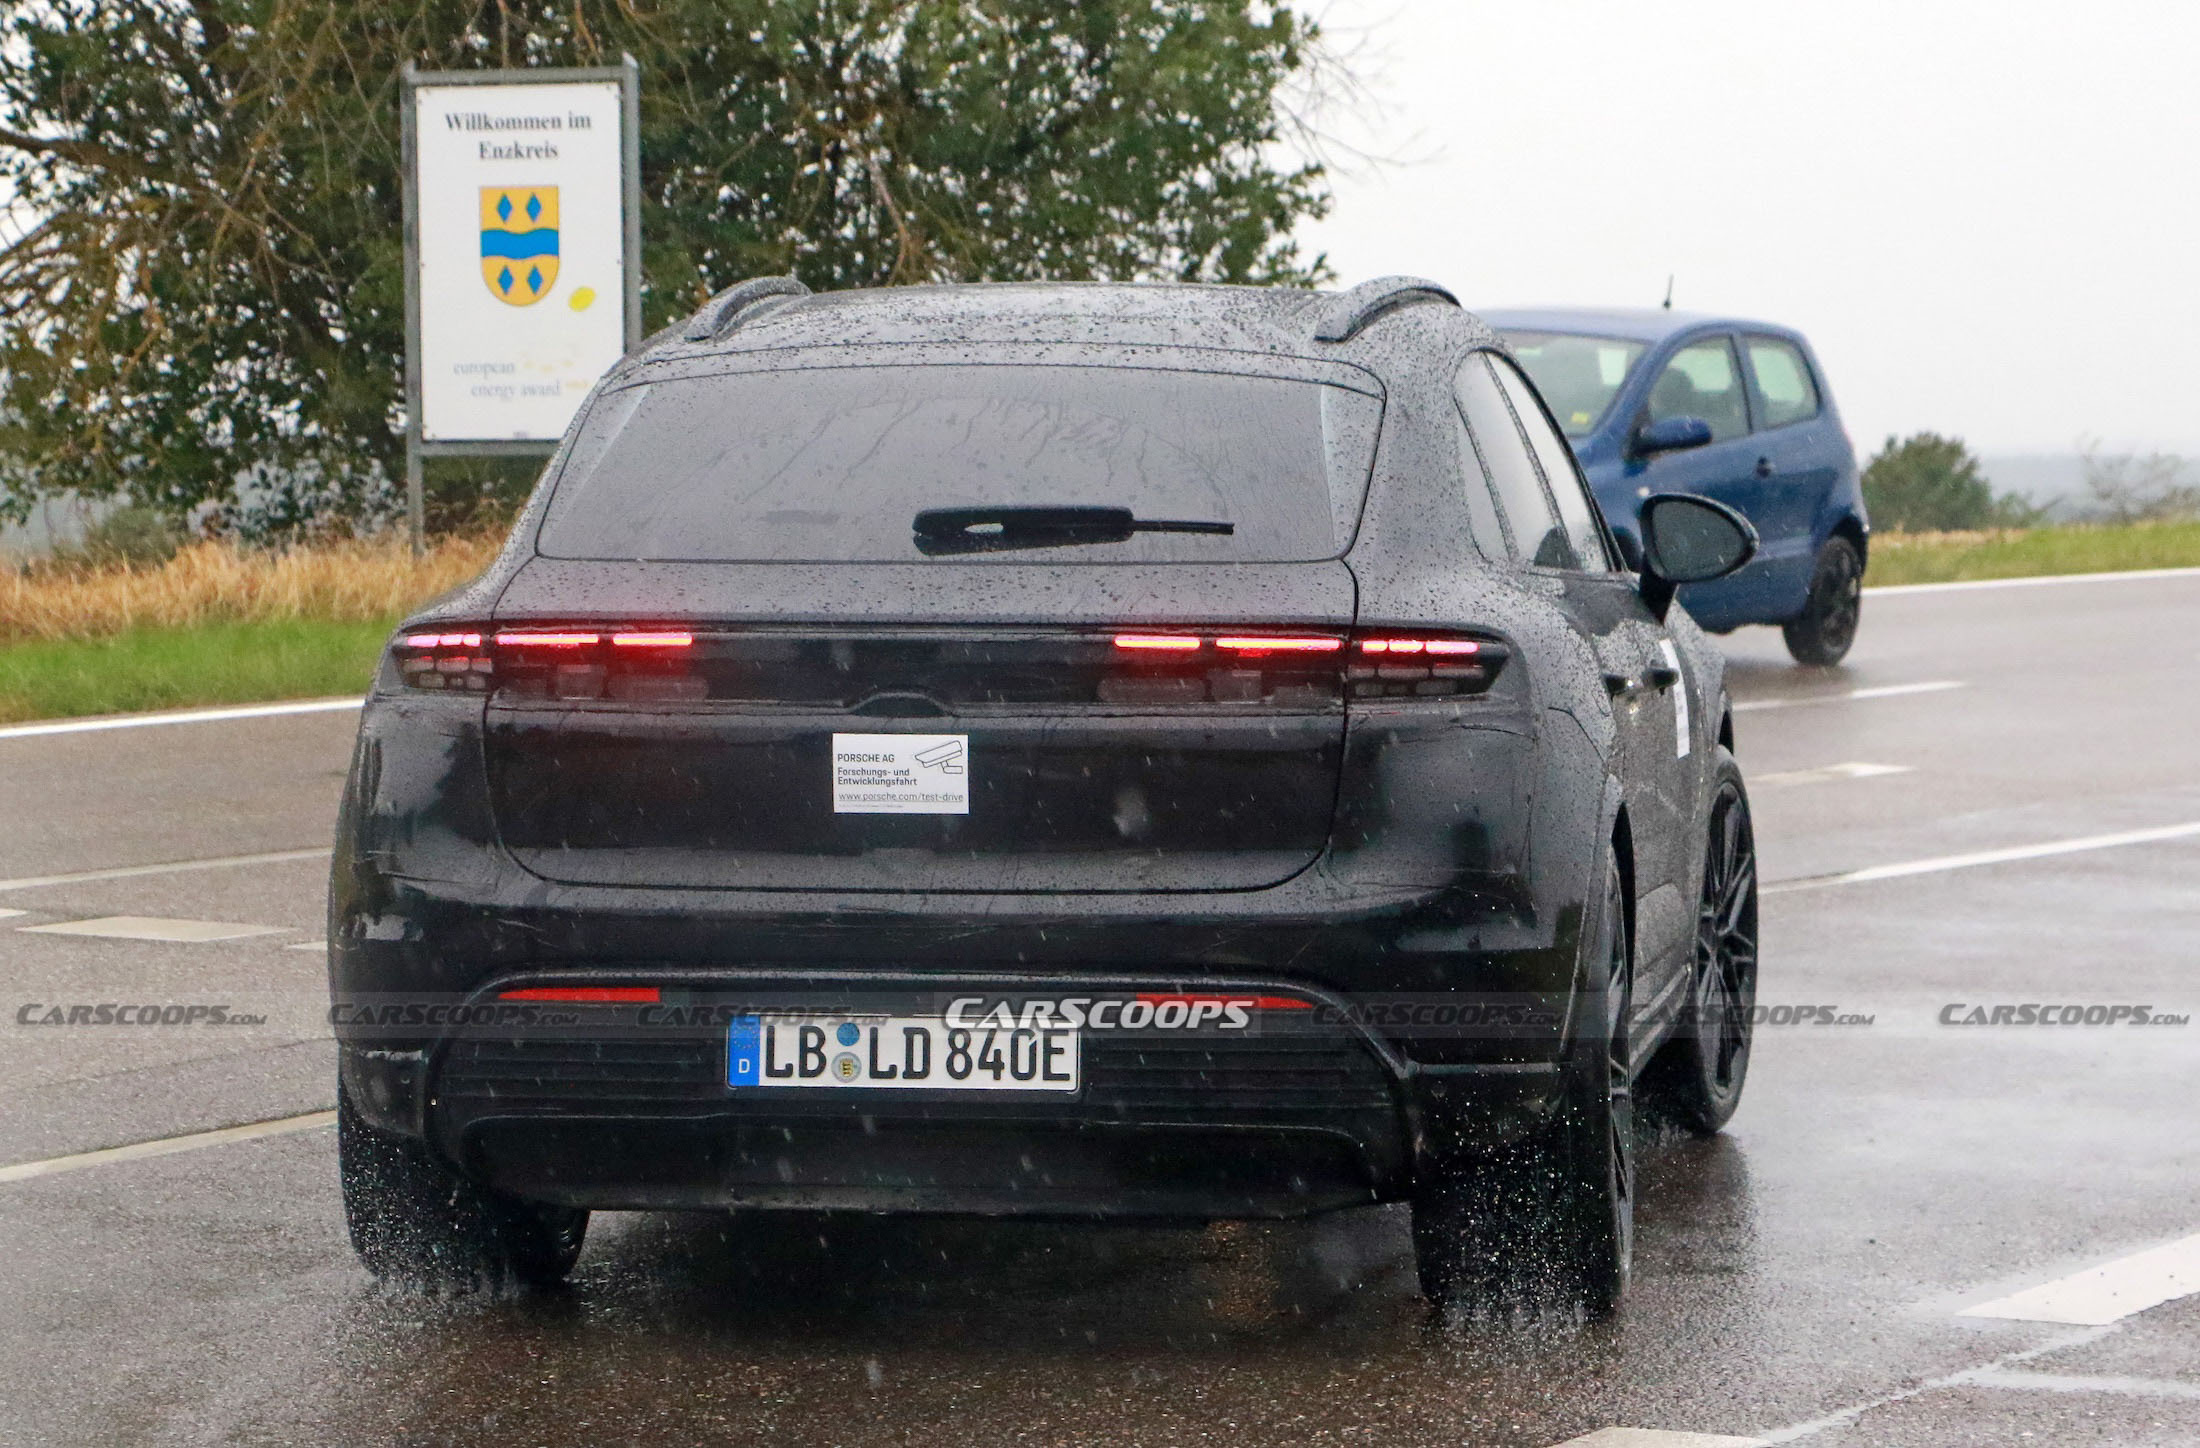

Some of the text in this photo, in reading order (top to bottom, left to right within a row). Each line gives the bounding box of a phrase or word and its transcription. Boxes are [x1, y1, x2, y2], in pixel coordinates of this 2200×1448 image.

[445, 111, 592, 131] Willkommen im
[479, 140, 559, 160] Enzkreis
[453, 362, 515, 379] european
[471, 380, 561, 399] energy award
[837, 753, 895, 763] PORSCHE AG
[837, 767, 910, 778] Forschungs- und
[837, 777, 918, 787] Entwicklungsfahrt
[838, 792, 964, 802] www.porsche.com/test-drive
[765, 1025, 1070, 1081] LB LD 840E
[738, 1058, 750, 1074] D
